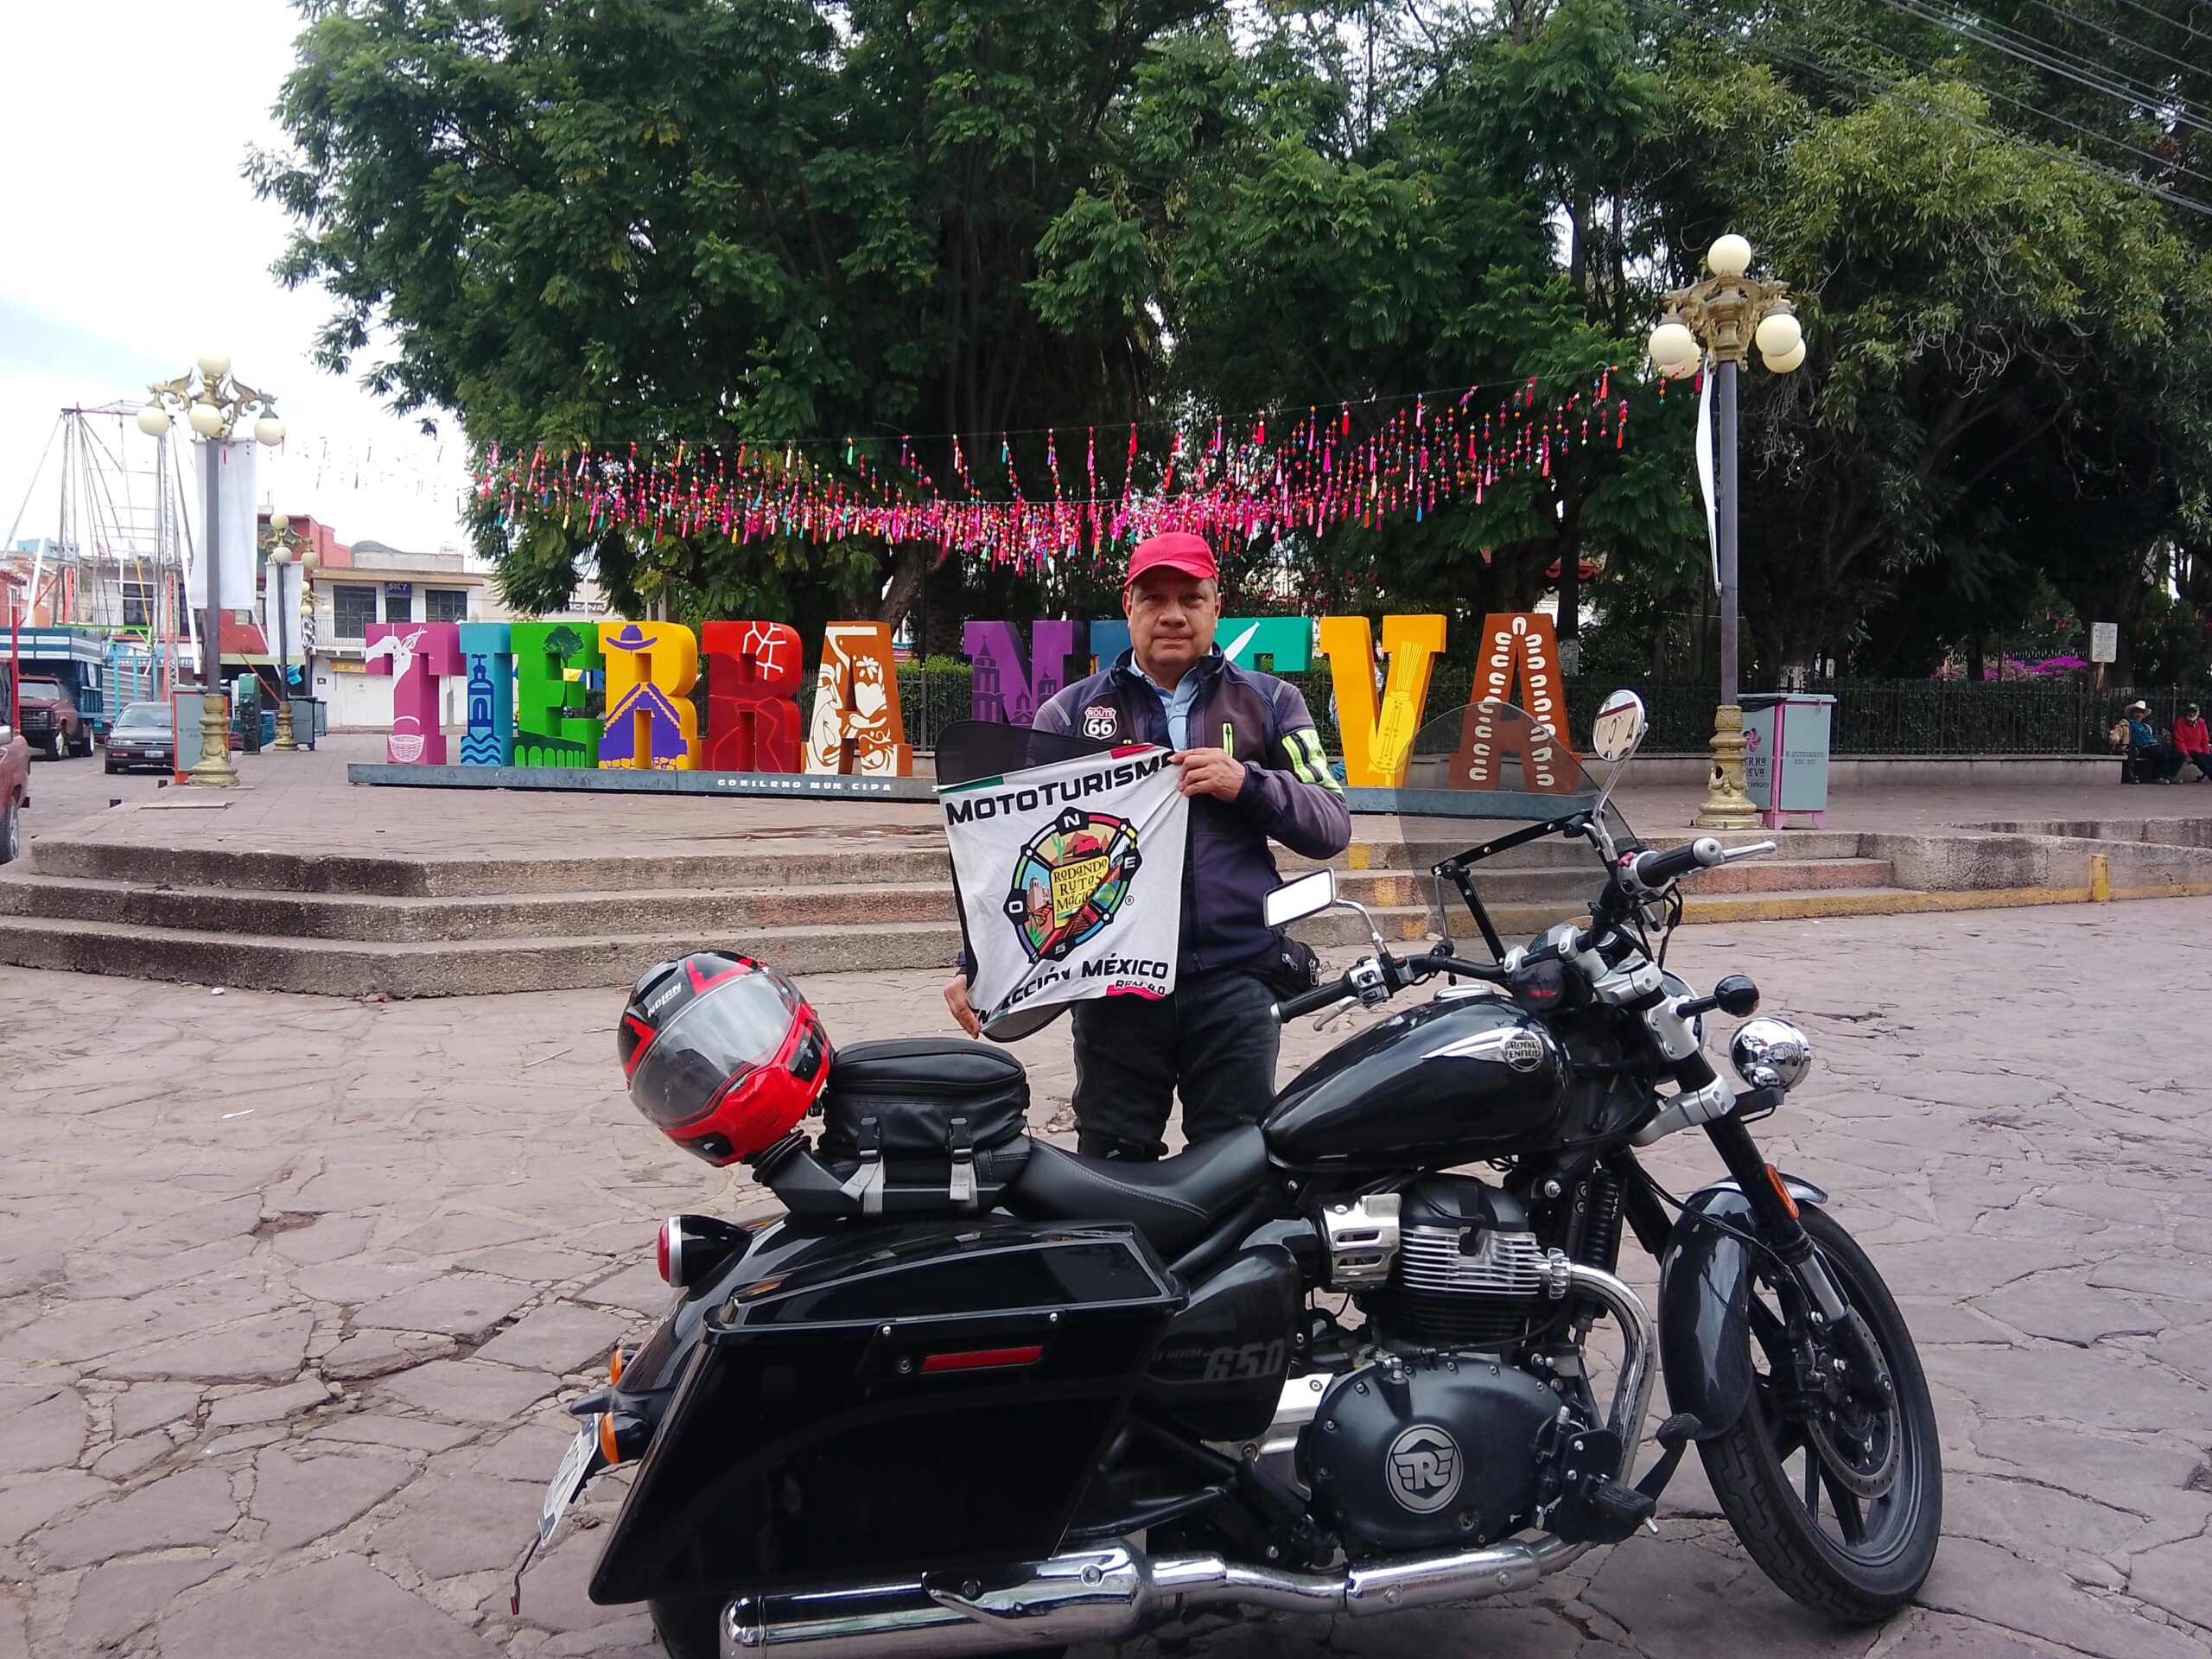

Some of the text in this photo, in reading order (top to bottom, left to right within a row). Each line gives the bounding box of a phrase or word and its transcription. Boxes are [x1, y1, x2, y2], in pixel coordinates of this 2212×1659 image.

[365, 620, 913, 777] TIERRA
[1088, 719, 1113, 735] 66
[1063, 813, 1081, 829] N
[1124, 856, 1136, 869] E
[1081, 952, 1168, 980] MÉXICO
[1147, 982, 1166, 995] 4.0
[647, 982, 682, 1018] NOLAN
[1510, 1040, 1536, 1049] ROYAL
[1509, 1049, 1541, 1058] ENFIELD
[1202, 1339, 1286, 1381] 650
